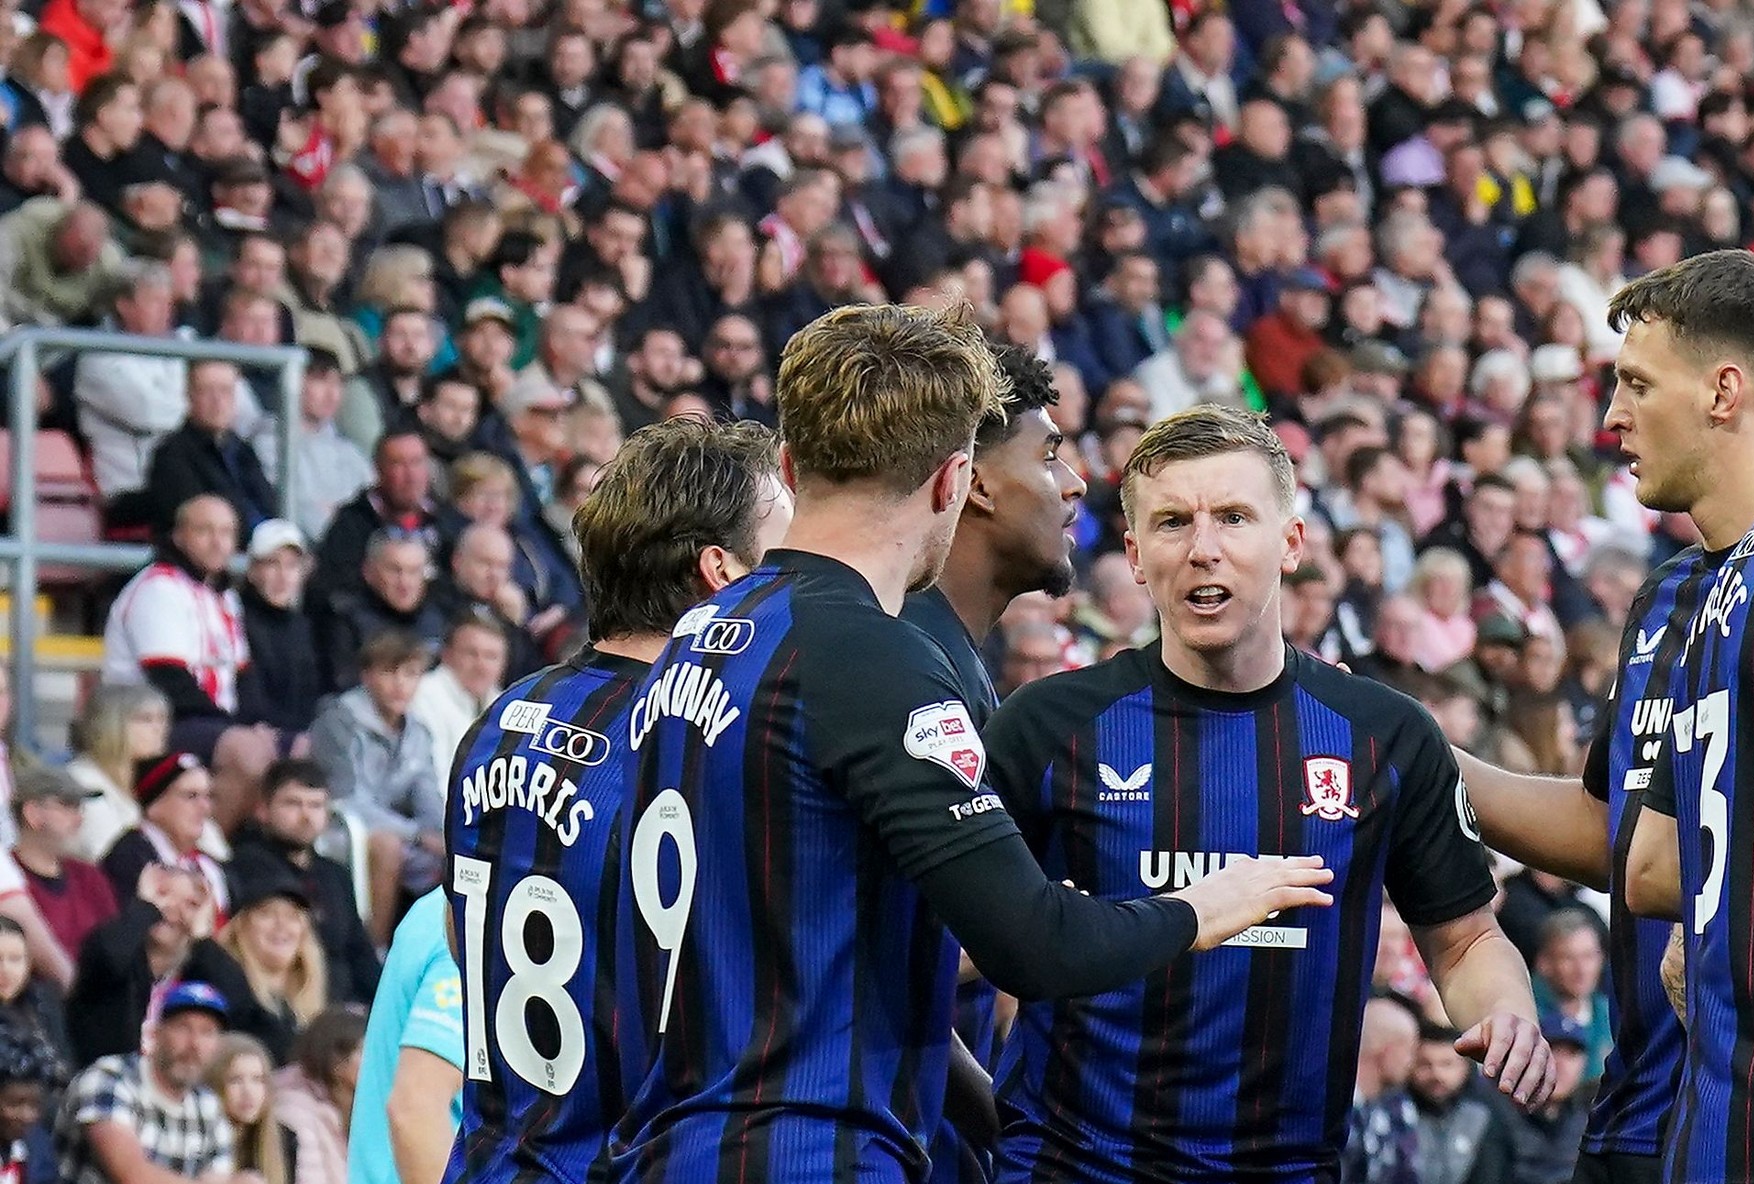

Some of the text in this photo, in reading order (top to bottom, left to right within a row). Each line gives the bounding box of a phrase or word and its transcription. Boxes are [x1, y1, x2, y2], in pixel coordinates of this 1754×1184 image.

[704, 622, 741, 650] CO
[508, 704, 540, 730] PER
[630, 661, 741, 751] CONWAY
[1631, 698, 1674, 736] UNI
[545, 729, 594, 759] CO
[915, 726, 939, 742] sky
[462, 755, 594, 847] MORRIS
[1099, 791, 1150, 801] CASTORE
[631, 788, 697, 1033] 9
[453, 855, 584, 1096] 18
